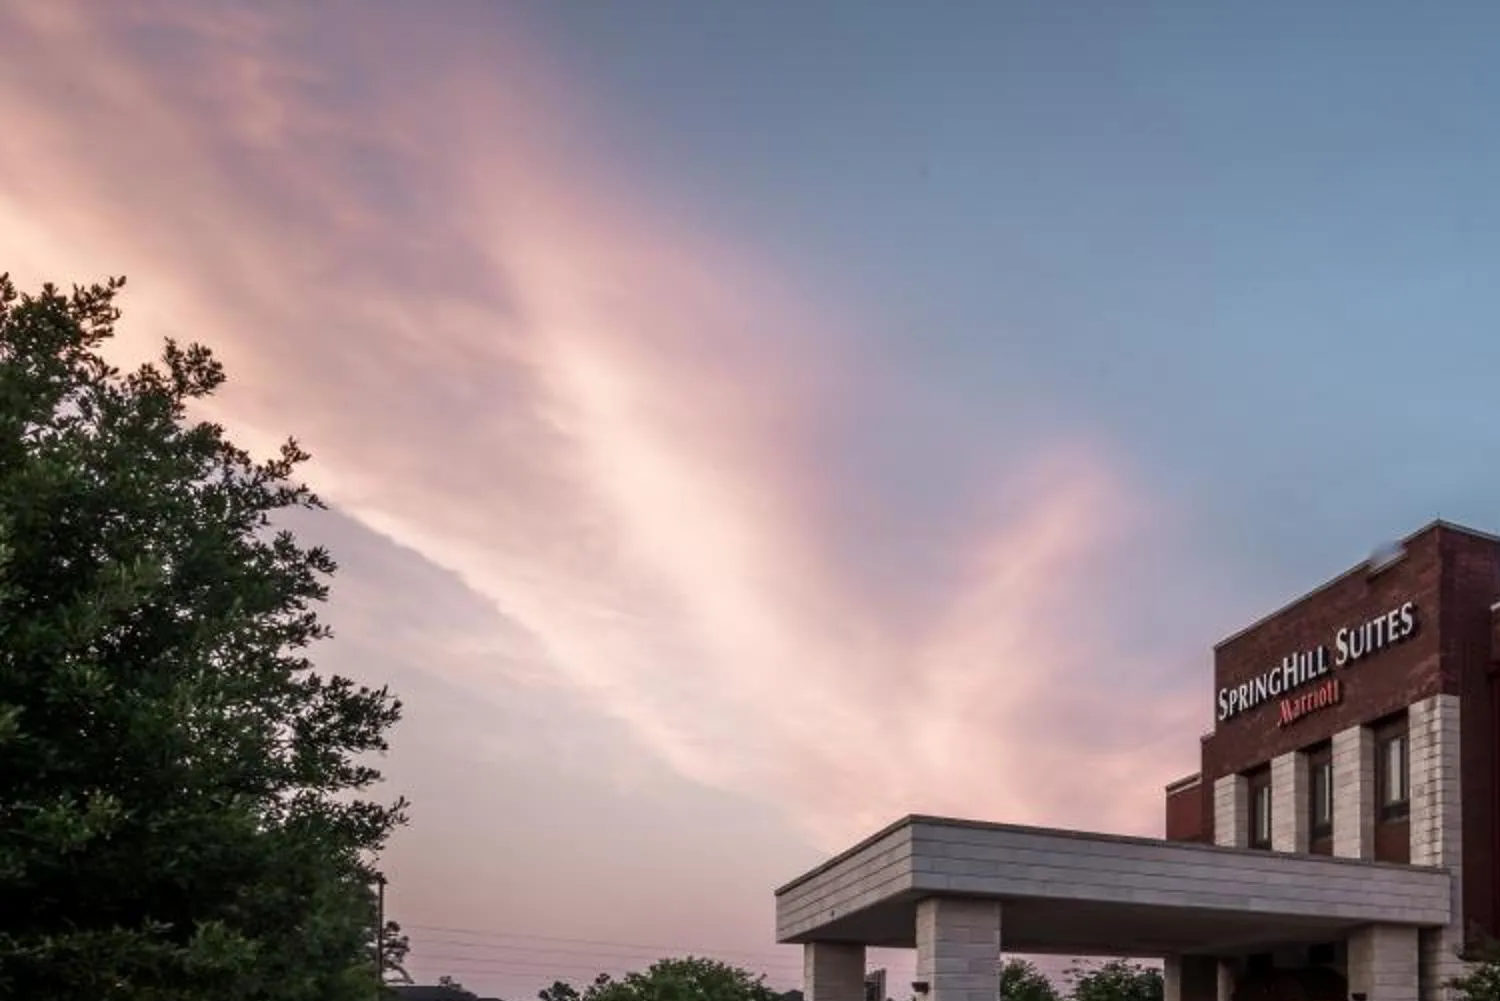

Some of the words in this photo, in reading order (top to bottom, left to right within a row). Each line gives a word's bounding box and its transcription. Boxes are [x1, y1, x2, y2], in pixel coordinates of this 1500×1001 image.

[1217, 645, 1328, 721] SPRINGHILL
[1335, 601, 1413, 666] SUITES
[1276, 679, 1339, 728] Marriott
